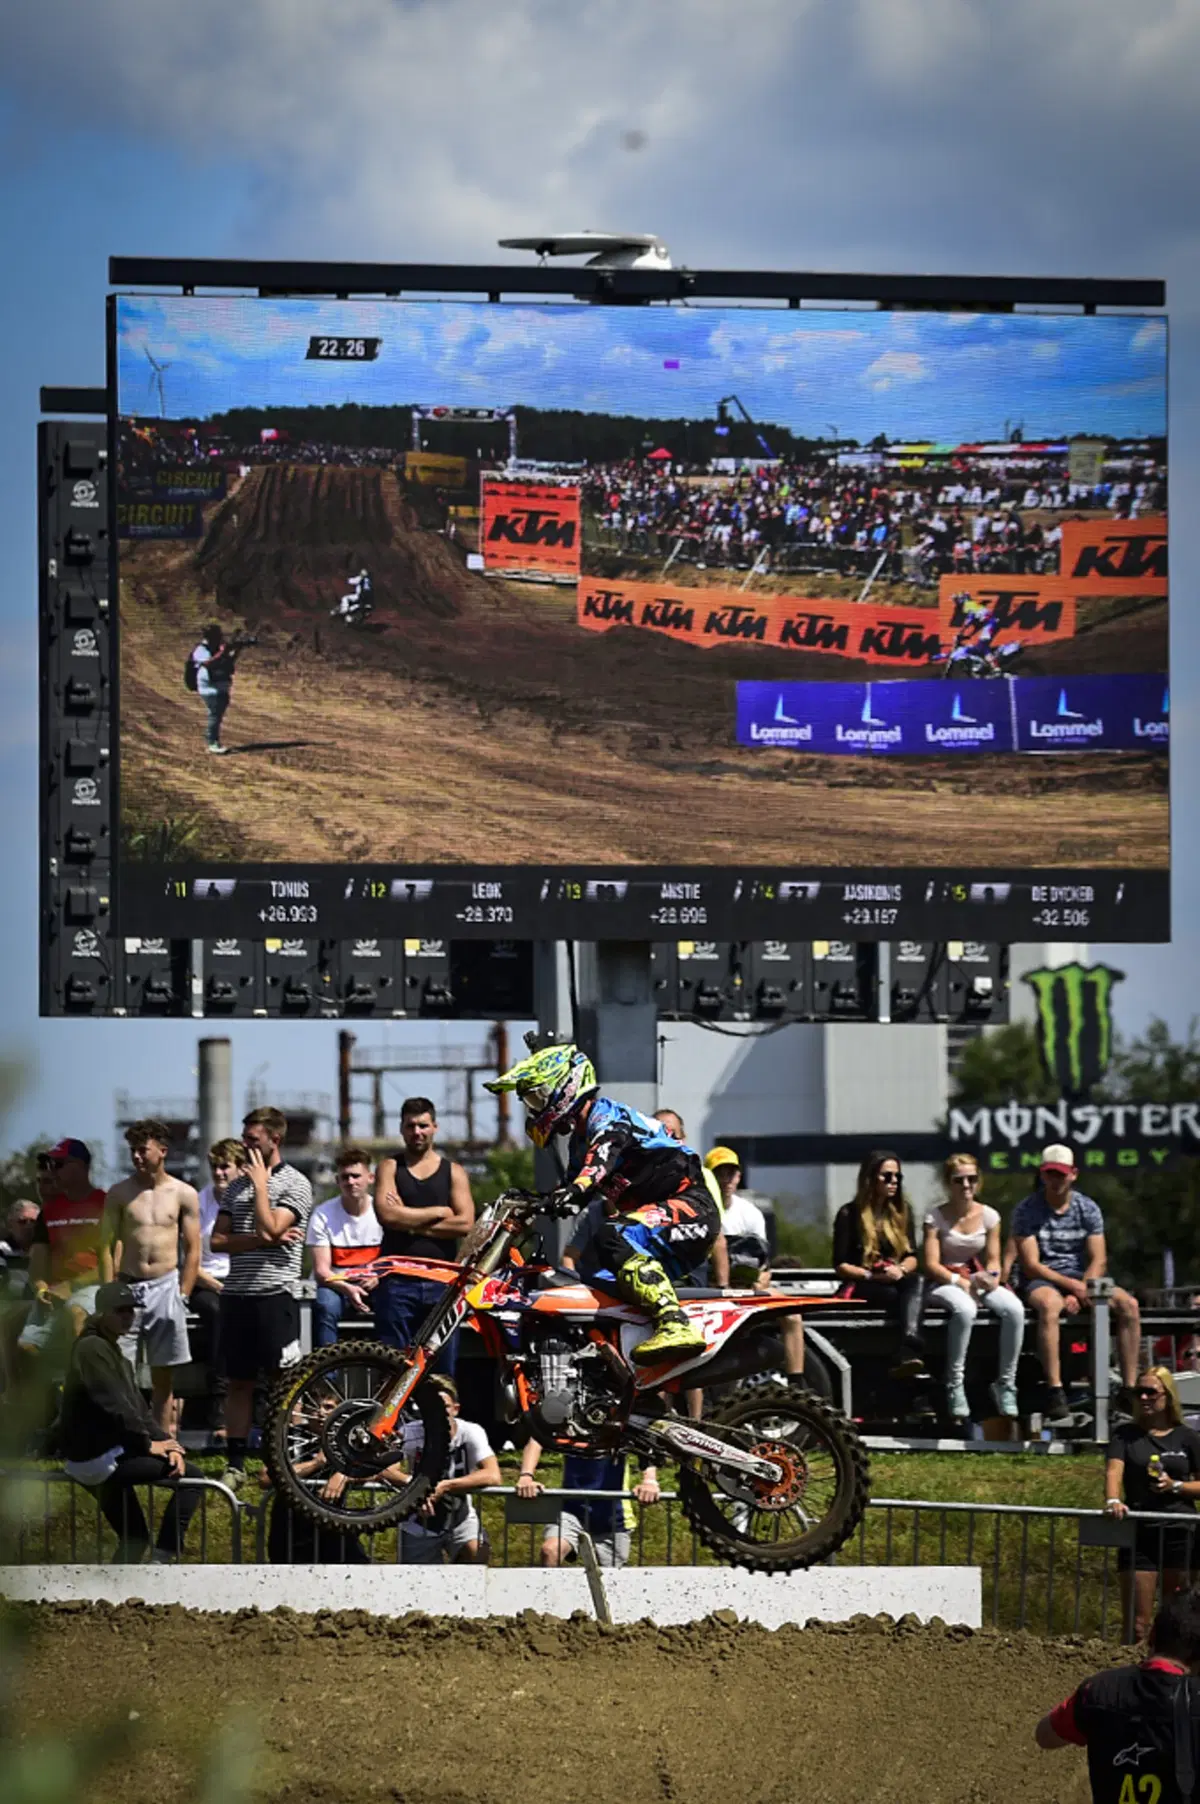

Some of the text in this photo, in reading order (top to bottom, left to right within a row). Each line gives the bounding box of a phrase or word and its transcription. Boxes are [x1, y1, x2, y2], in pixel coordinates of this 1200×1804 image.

[488, 508, 577, 548] KTM
[584, 590, 942, 659] KTM KTM KTM KTM KTM
[751, 723, 812, 741] Lommel
[836, 724, 902, 742] Lommel
[926, 723, 994, 742] Lommel
[1030, 719, 1104, 738] Lommel
[990, 1149, 1169, 1169] ENRGY
